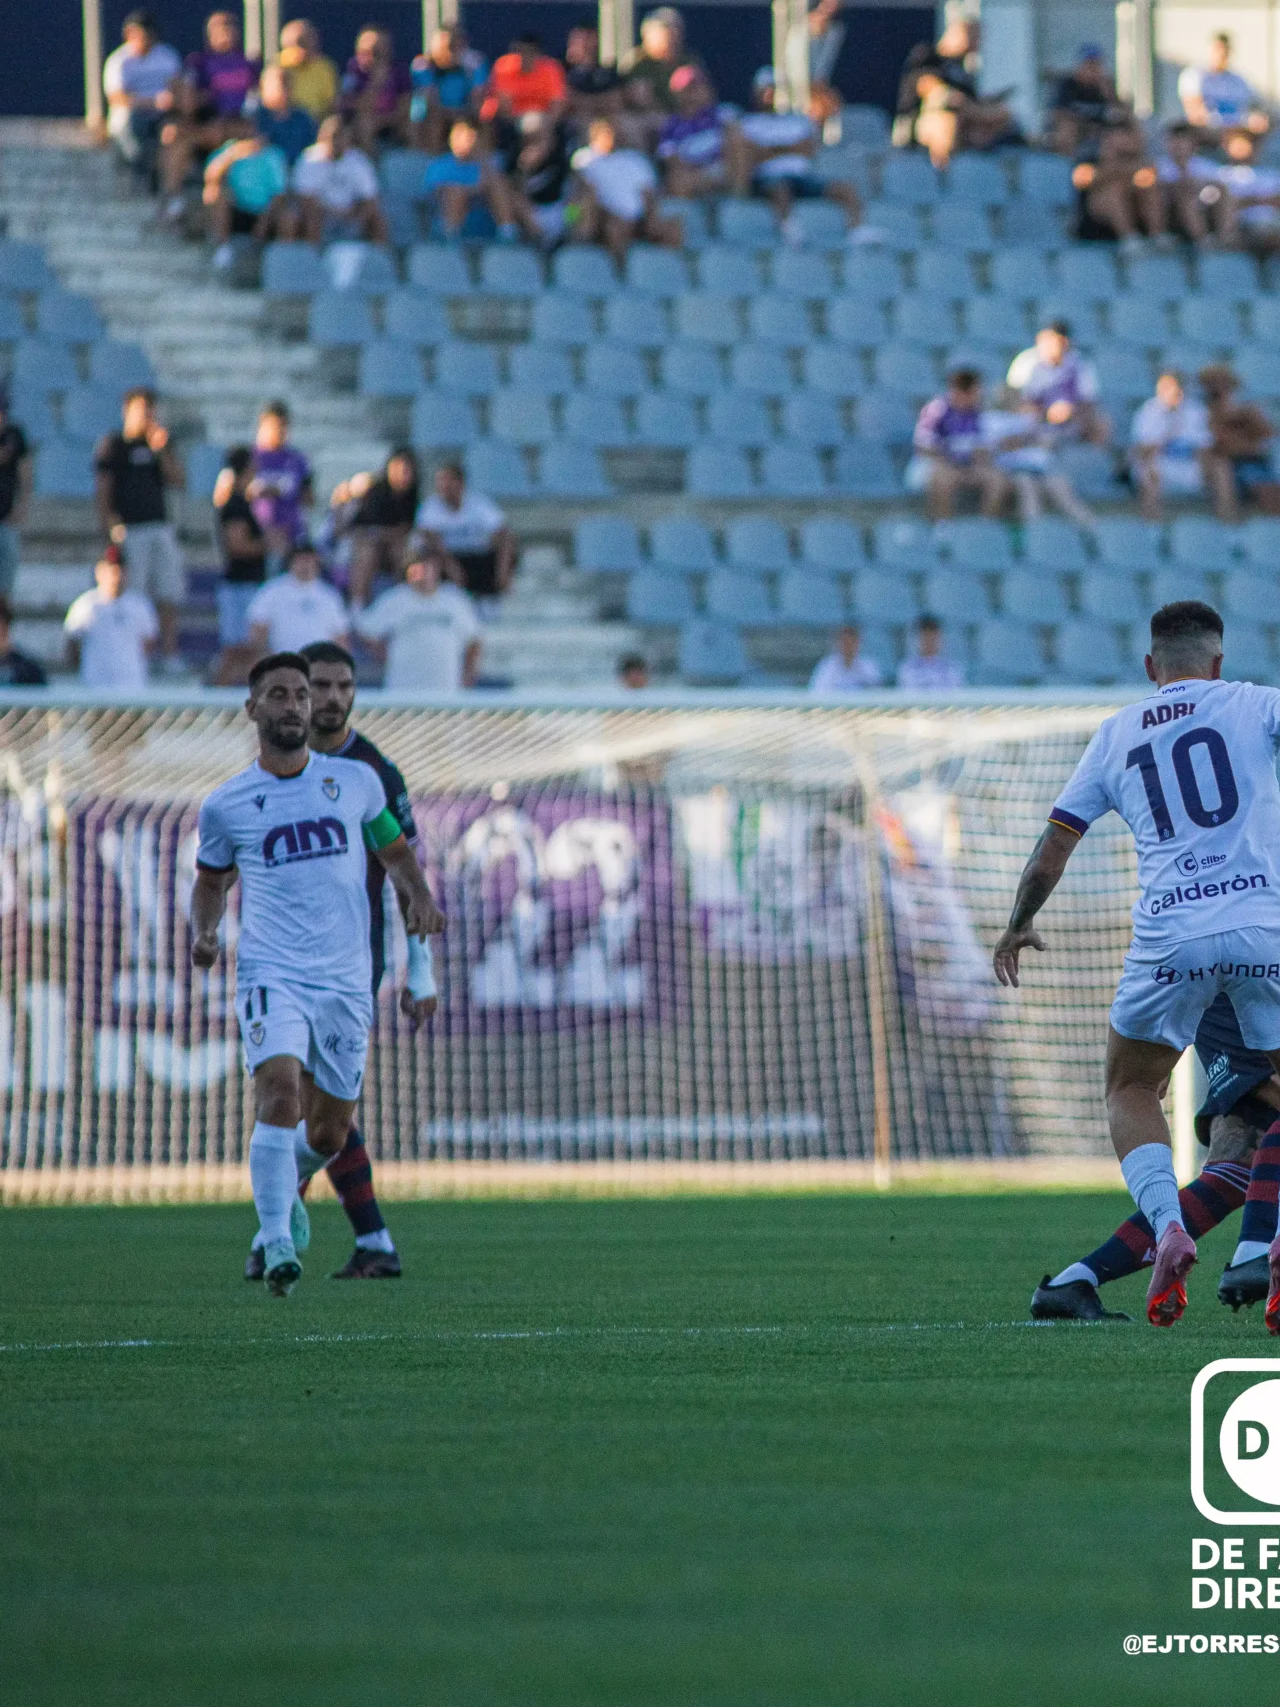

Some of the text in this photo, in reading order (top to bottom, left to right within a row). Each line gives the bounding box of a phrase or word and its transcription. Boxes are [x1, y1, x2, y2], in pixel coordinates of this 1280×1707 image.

[1142, 703, 1196, 729] ADRI
[1126, 727, 1239, 842] 10
[1201, 854, 1226, 865] clibo
[245, 985, 268, 1020] 11
